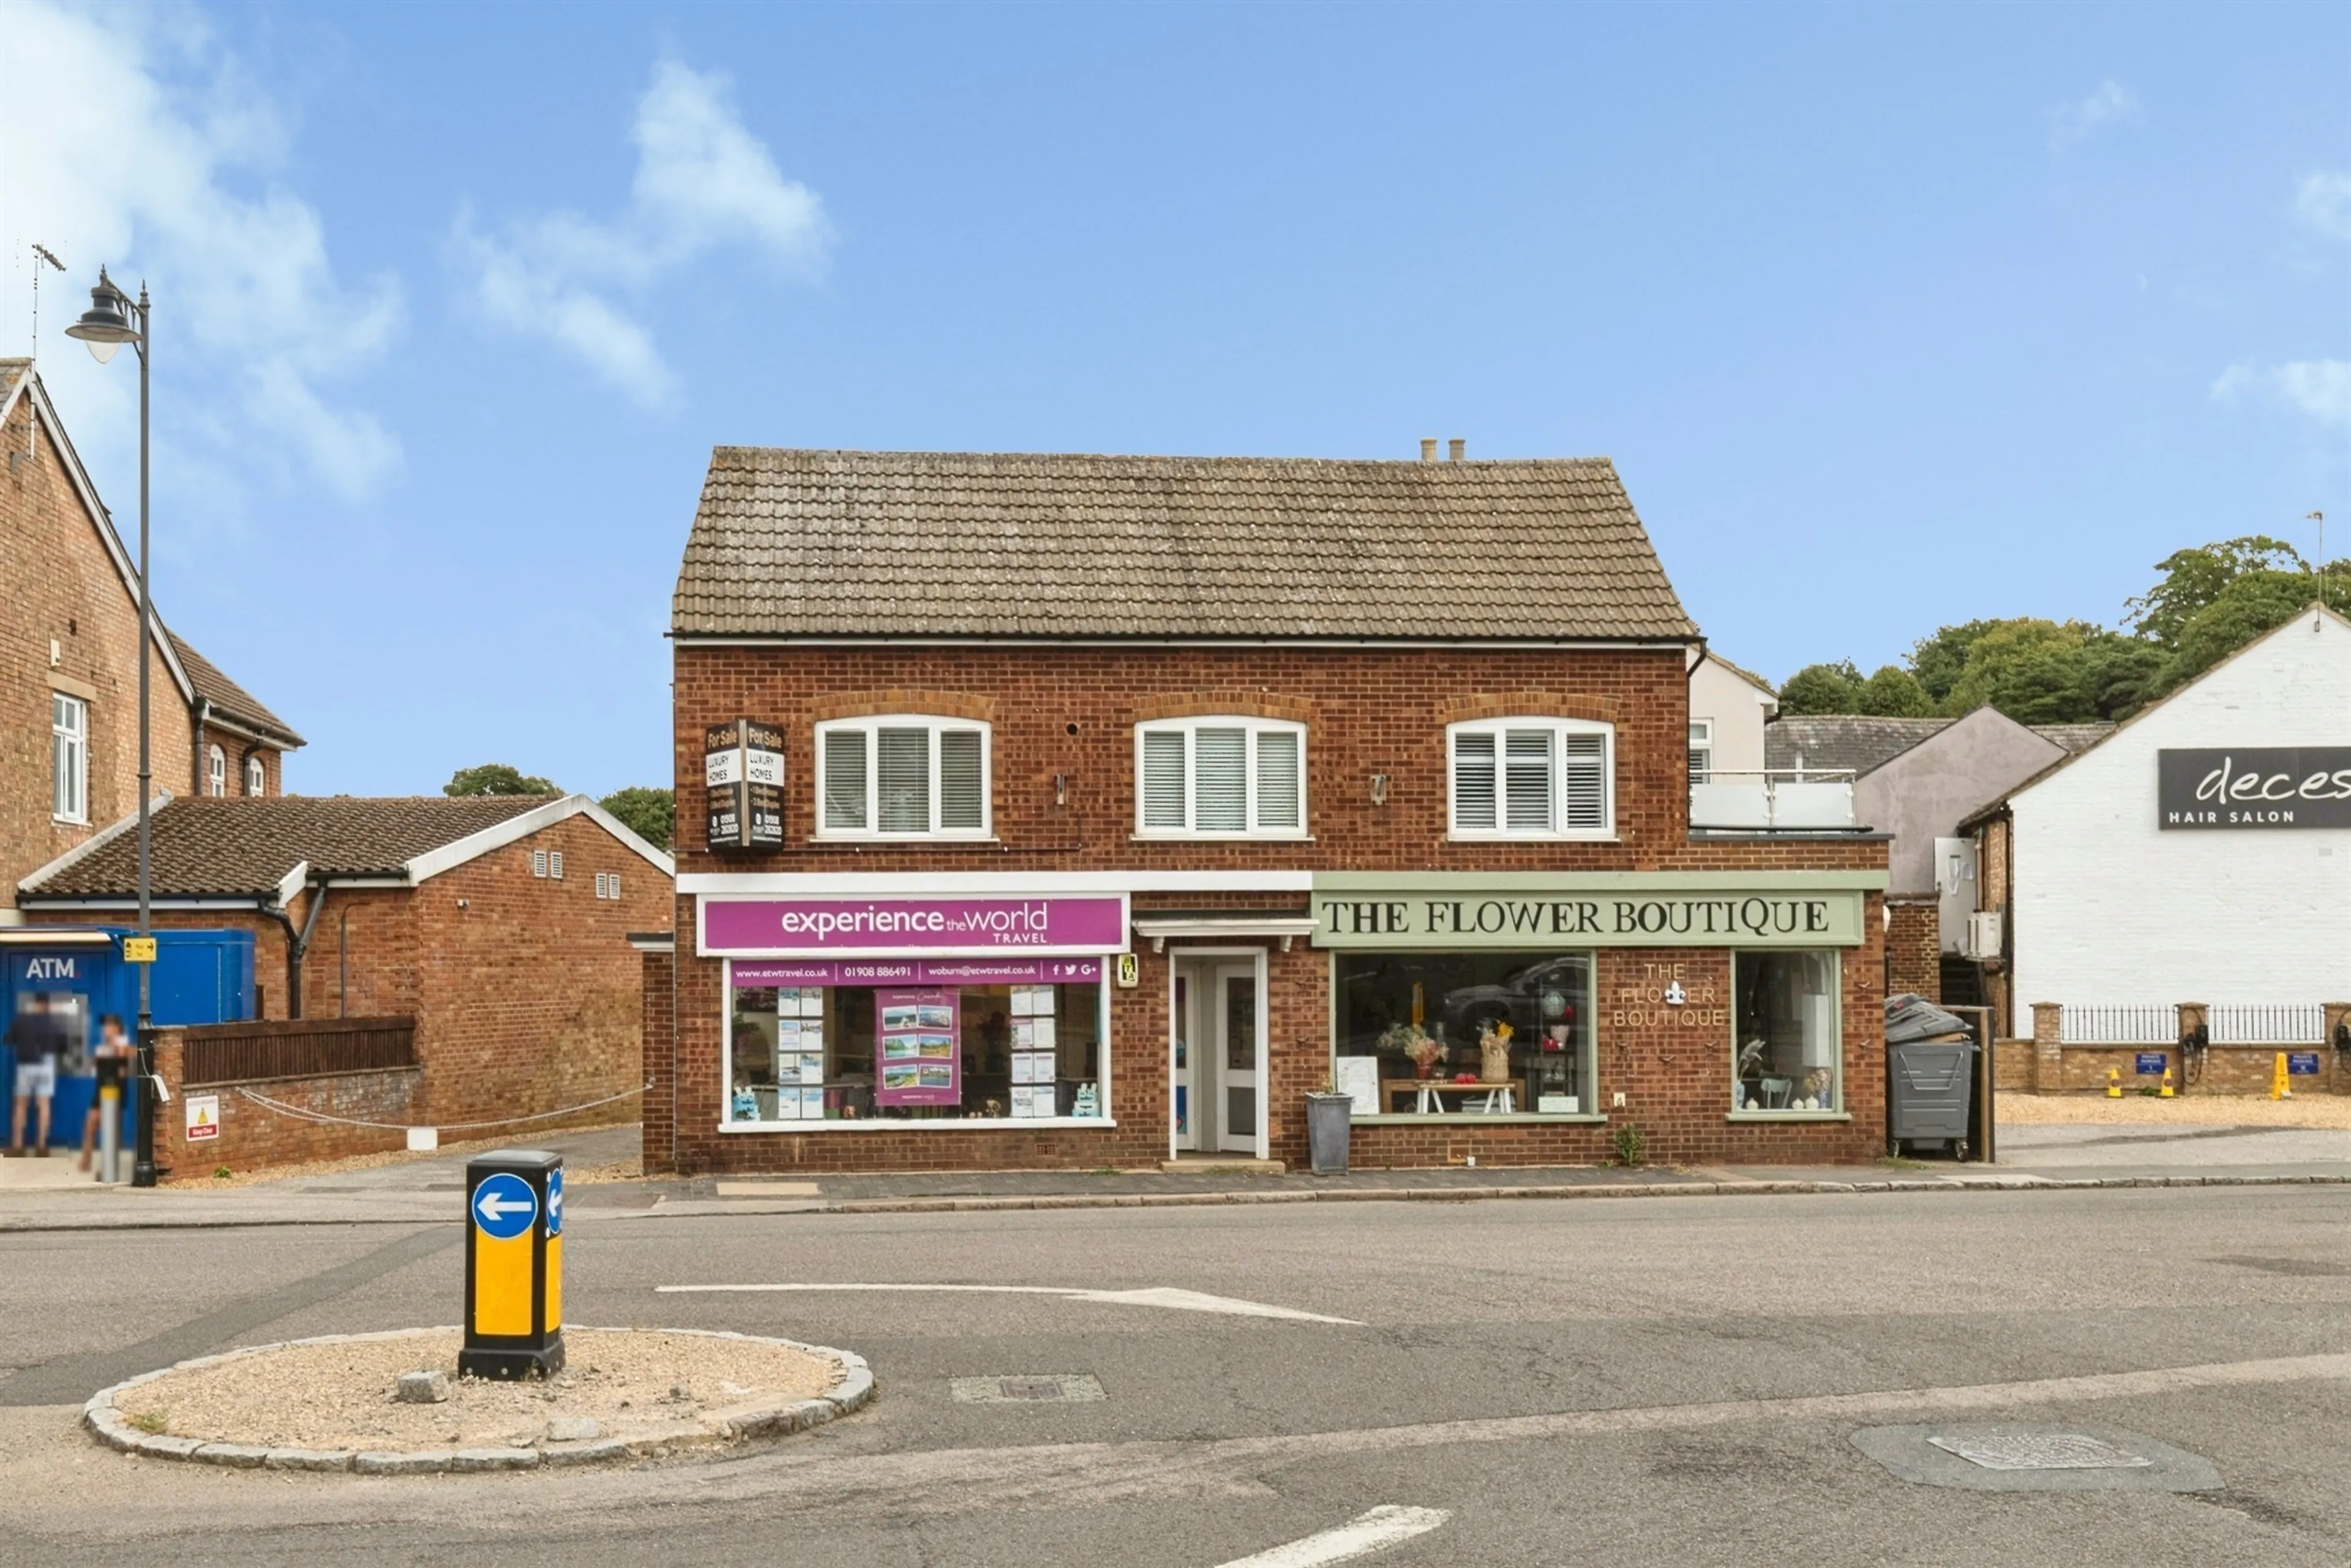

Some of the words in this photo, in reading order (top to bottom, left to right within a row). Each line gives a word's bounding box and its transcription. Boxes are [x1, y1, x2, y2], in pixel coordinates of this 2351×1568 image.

[708, 733, 720, 748] For
[721, 729, 737, 746] Sale
[748, 727, 763, 744] For
[764, 730, 782, 748] Sale
[749, 753, 774, 767] LUXURY
[749, 767, 773, 781] HOMES
[2169, 811, 2217, 823] HAIR
[2229, 811, 2294, 823] SALON
[781, 905, 944, 940] experience
[947, 918, 967, 931] the
[963, 902, 1048, 931] world
[1321, 901, 1409, 934] THE
[1425, 901, 1604, 934] FLOWER
[1613, 898, 1830, 937] BOUTIQUE
[993, 932, 1047, 943] TRAVEL
[735, 967, 828, 978] www.etwtravel.co.uk
[845, 967, 874, 977] 01908
[876, 966, 911, 977] 886491
[928, 965, 1036, 977] woburn@etwtravel.co.uk
[1644, 963, 1685, 980] THE
[1622, 983, 1715, 1004] FLOER
[1613, 1010, 1726, 1027] BOUTIQUE
